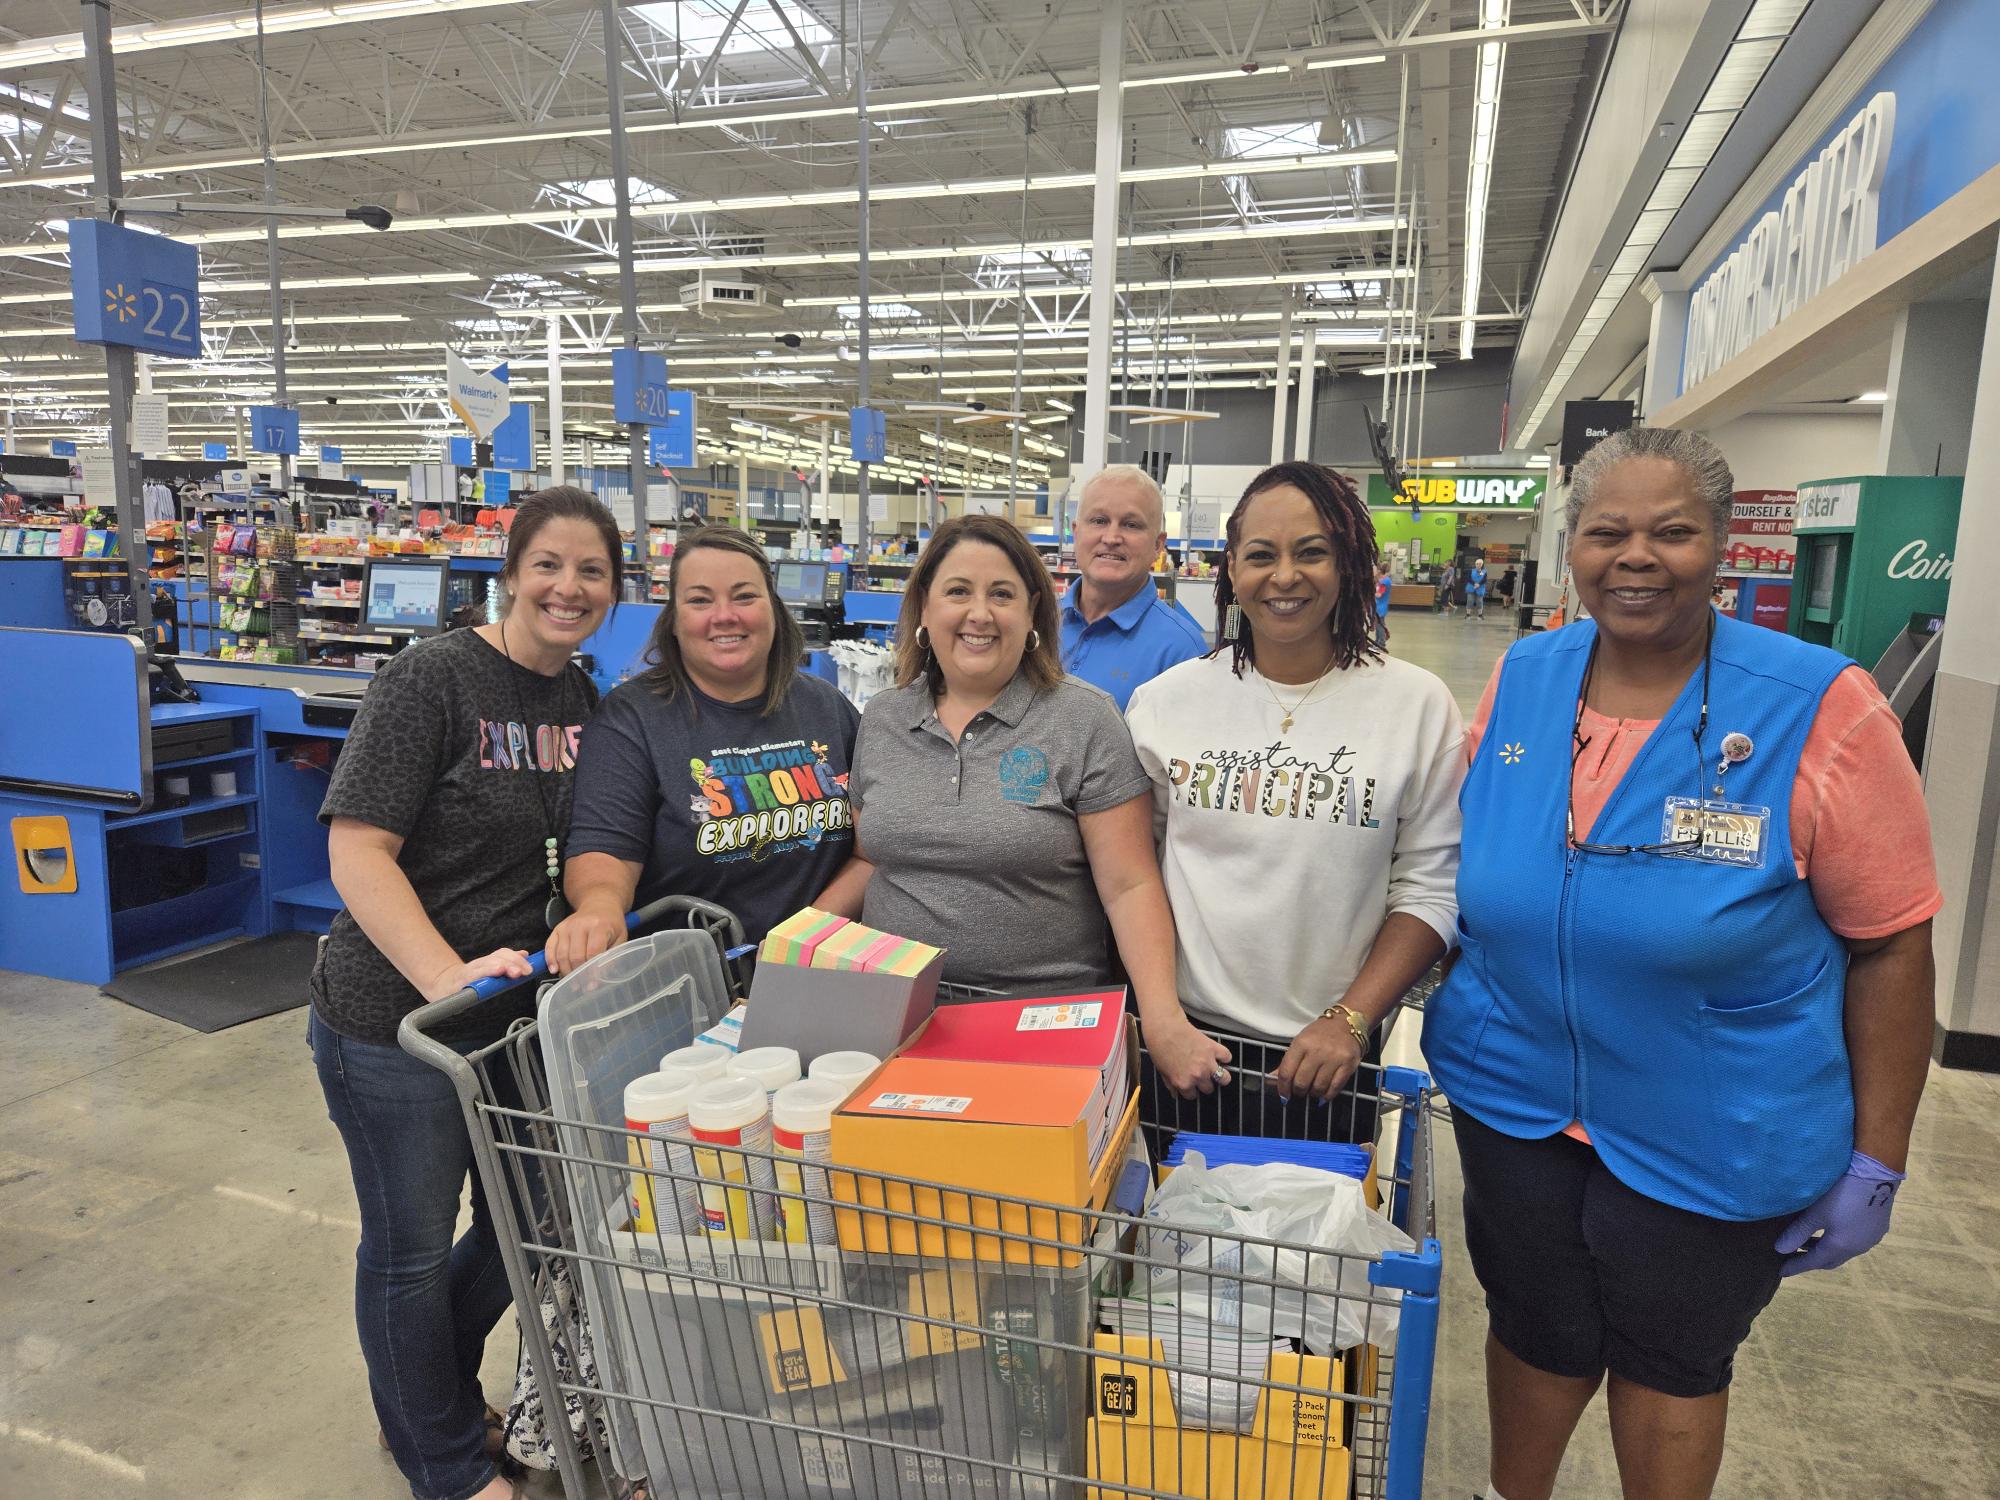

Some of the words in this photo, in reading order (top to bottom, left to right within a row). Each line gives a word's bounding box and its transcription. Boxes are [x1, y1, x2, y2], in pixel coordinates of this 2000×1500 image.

[1769, 91, 1896, 329] CENTER
[143, 288, 192, 341] 22
[648, 387, 666, 417] 20
[266, 428, 285, 449] 17
[1585, 428, 1609, 437] Bank
[655, 442, 668, 451] Self
[655, 452, 683, 460] Checkout
[1392, 477, 1536, 504] SUBWAY
[1762, 494, 1797, 503] RugDocto
[1731, 505, 1781, 518] OURSELF
[1784, 507, 1792, 517] &
[1752, 521, 1776, 532] RENT
[761, 740, 806, 751] Elementary
[709, 748, 816, 776] BUILDING
[1201, 741, 1357, 775] assistant
[701, 764, 845, 817] STRONG
[1168, 758, 1380, 828] PRINCIPAL
[1305, 1401, 1325, 1411] Pack
[1293, 1420, 1316, 1430] heet
